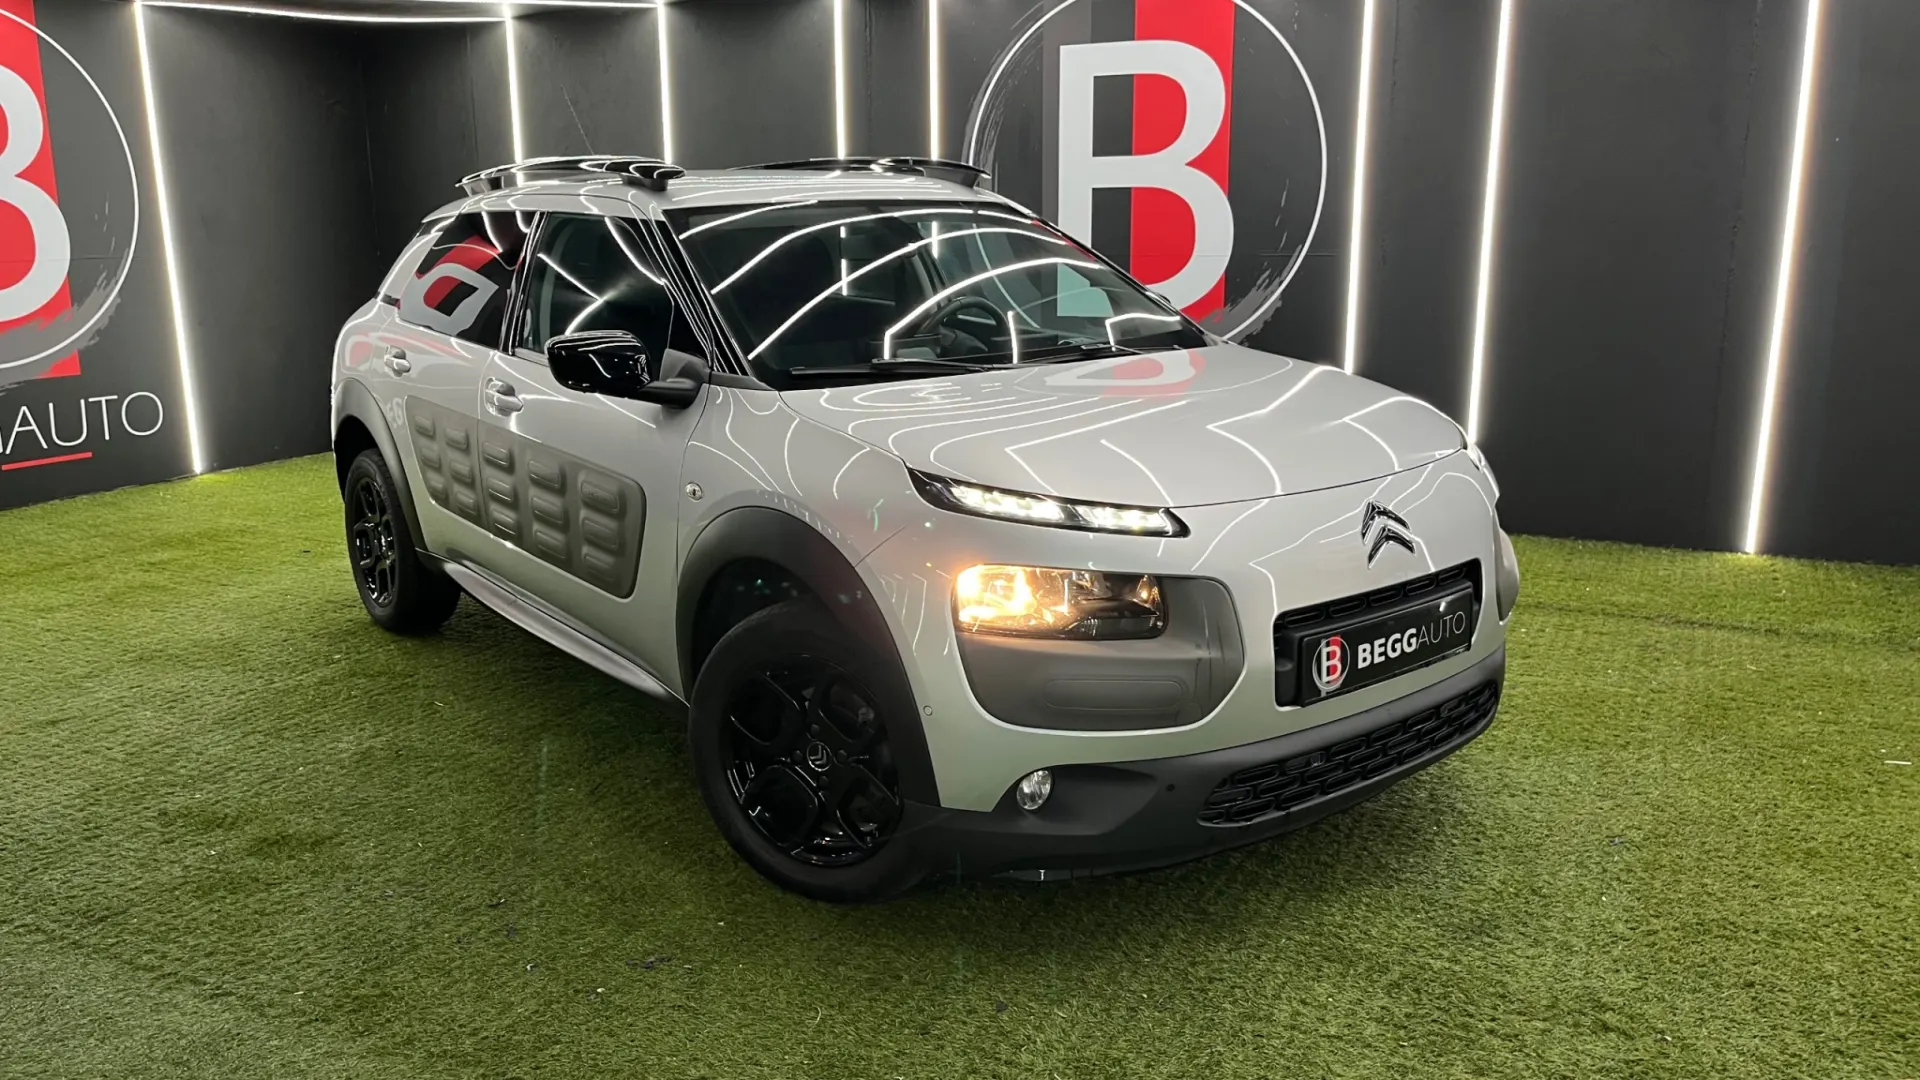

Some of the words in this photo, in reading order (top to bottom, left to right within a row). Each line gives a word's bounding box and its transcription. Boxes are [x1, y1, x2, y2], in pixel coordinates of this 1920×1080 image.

[1057, 40, 1234, 316] B
[0, 391, 163, 454] AUTO
[1321, 645, 1342, 683] B
[1357, 611, 1466, 669] BEGGAUTO
